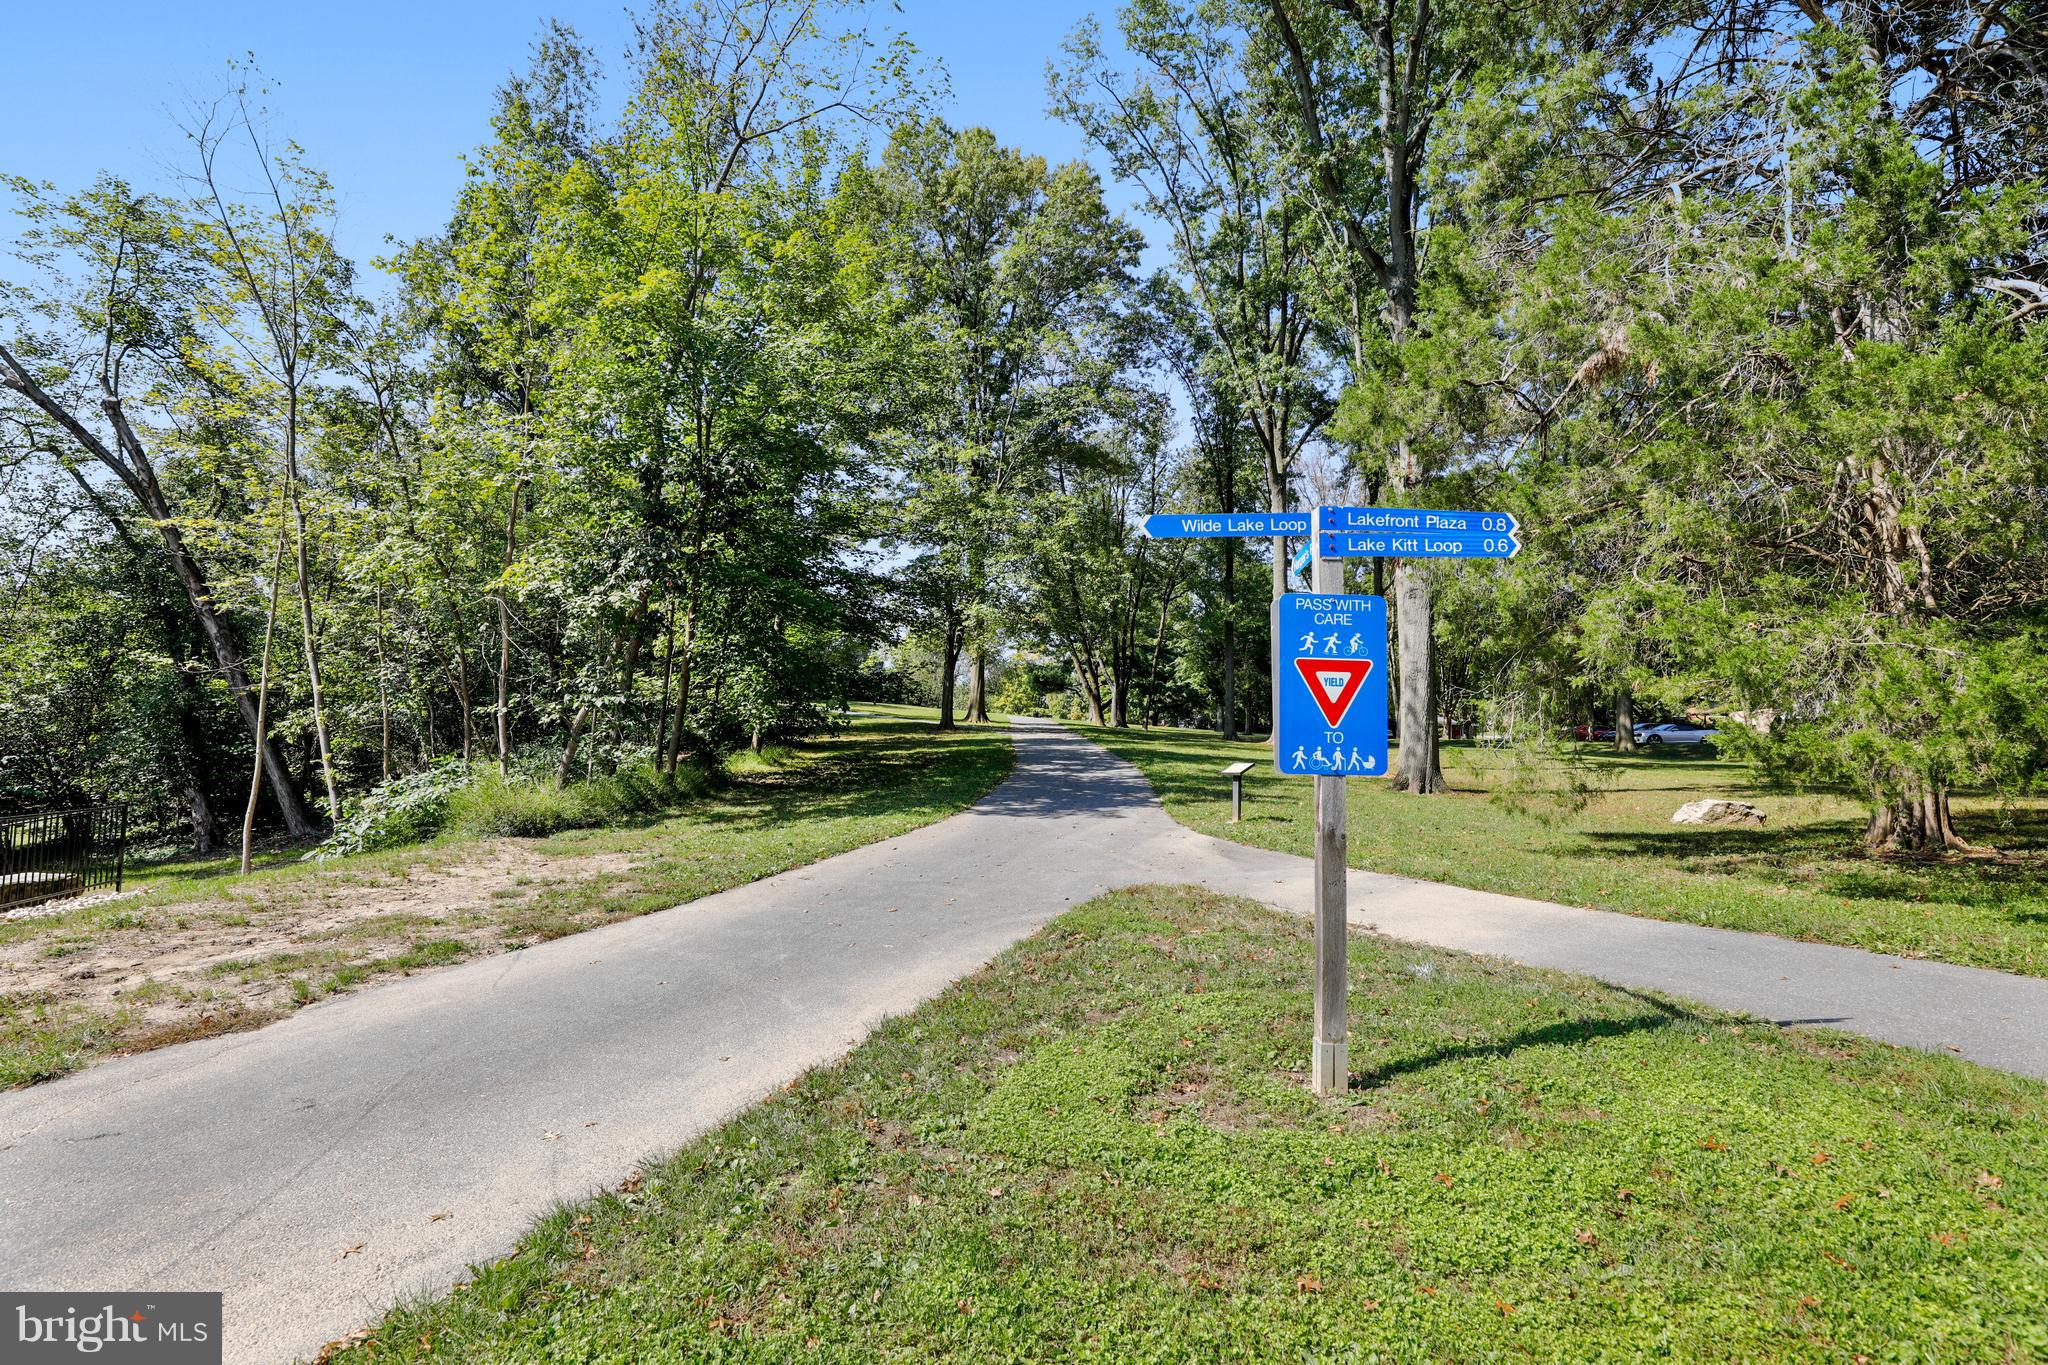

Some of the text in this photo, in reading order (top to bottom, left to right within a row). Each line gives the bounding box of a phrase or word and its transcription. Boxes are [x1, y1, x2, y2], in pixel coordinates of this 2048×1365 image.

[1181, 518, 1307, 533] Wilde Lake Loop
[1347, 512, 1507, 532] Lakefront Plaza 0.8
[1348, 538, 1509, 554] Lake Kitt Loop 0.6
[1295, 598, 1371, 612] PASS WITH
[1314, 612, 1353, 626] CARE
[1323, 677, 1344, 687] YIELD
[1323, 731, 1344, 744] TO
